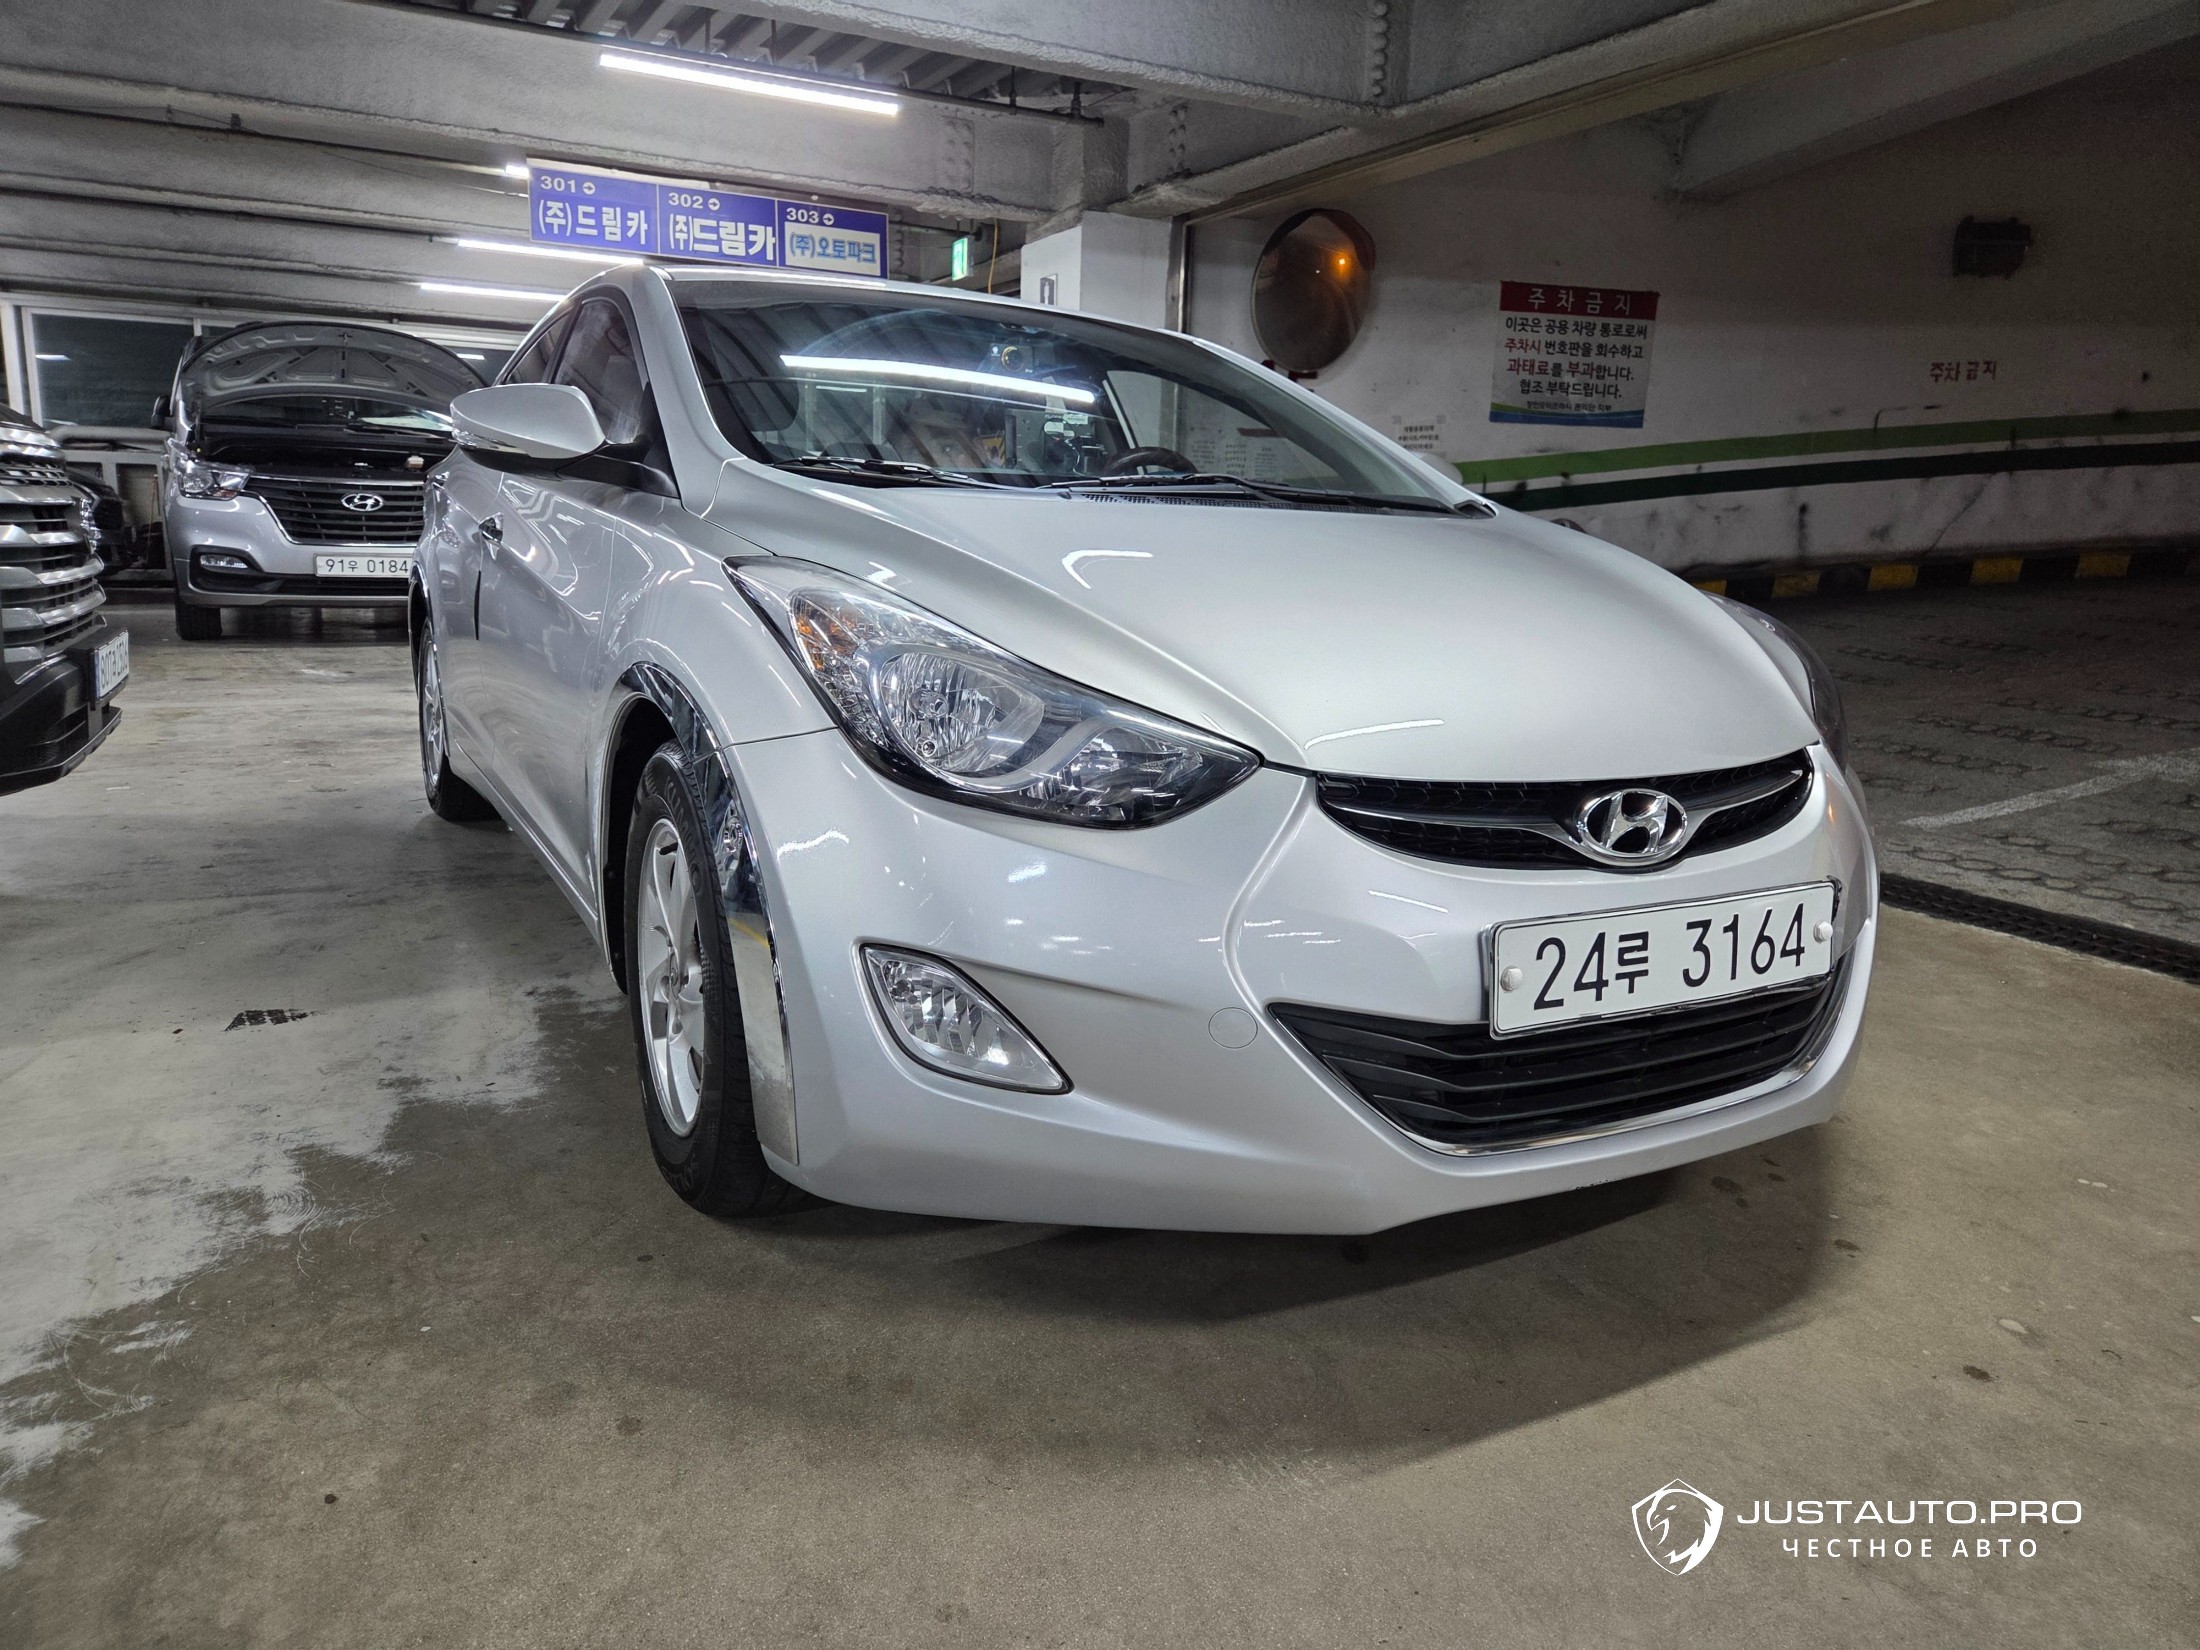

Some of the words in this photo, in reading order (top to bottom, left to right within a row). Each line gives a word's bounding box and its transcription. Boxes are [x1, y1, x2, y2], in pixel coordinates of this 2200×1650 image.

[540, 175, 576, 194] 301
[668, 191, 704, 209] 302
[786, 207, 820, 224] 303
[789, 231, 877, 264] (주)오토파크
[1505, 316, 1542, 334] 이곳은
[1544, 318, 1569, 335] 공용
[1571, 320, 1597, 337] 차량
[1599, 322, 1648, 340] 통로로써
[1504, 338, 1541, 354] 주차시
[1544, 340, 1593, 358] 번호판을
[1595, 343, 1644, 359] 회수하고
[1506, 357, 1564, 377] 과태료를
[1567, 361, 1634, 381] 부과합니다.
[1519, 379, 1543, 395] 협조
[1546, 380, 1622, 399] 부탁드립니다.
[325, 558, 358, 573] 91우
[366, 559, 409, 574] 0184
[1533, 930, 1650, 1011] 24루
[1682, 902, 1806, 989] 3164
